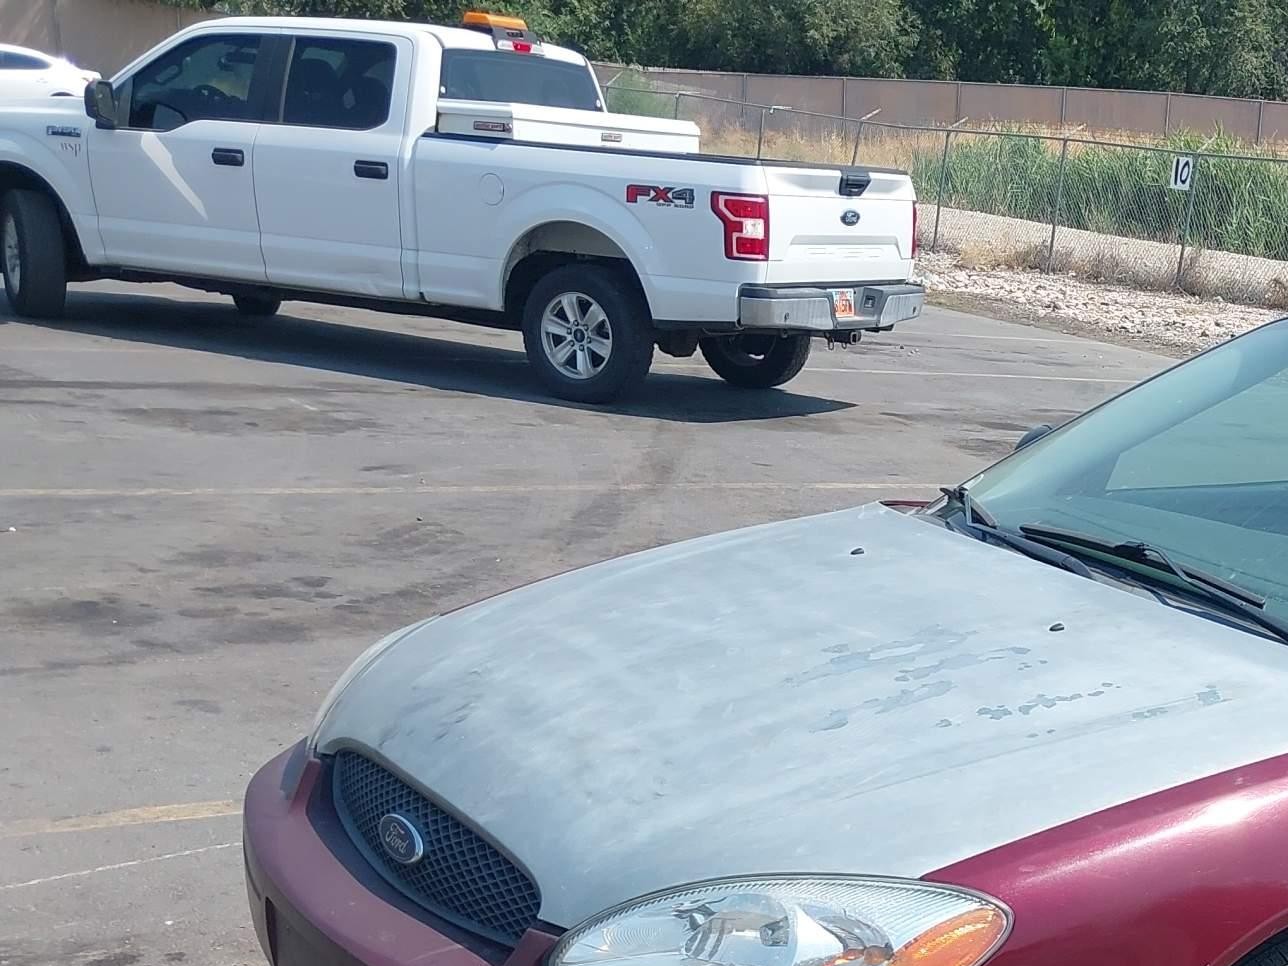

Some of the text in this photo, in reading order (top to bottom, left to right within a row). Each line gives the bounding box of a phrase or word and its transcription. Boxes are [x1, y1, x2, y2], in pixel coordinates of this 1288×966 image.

[1173, 158, 1190, 186] 10
[626, 184, 695, 205] FX4
[385, 822, 409, 854] Ford
